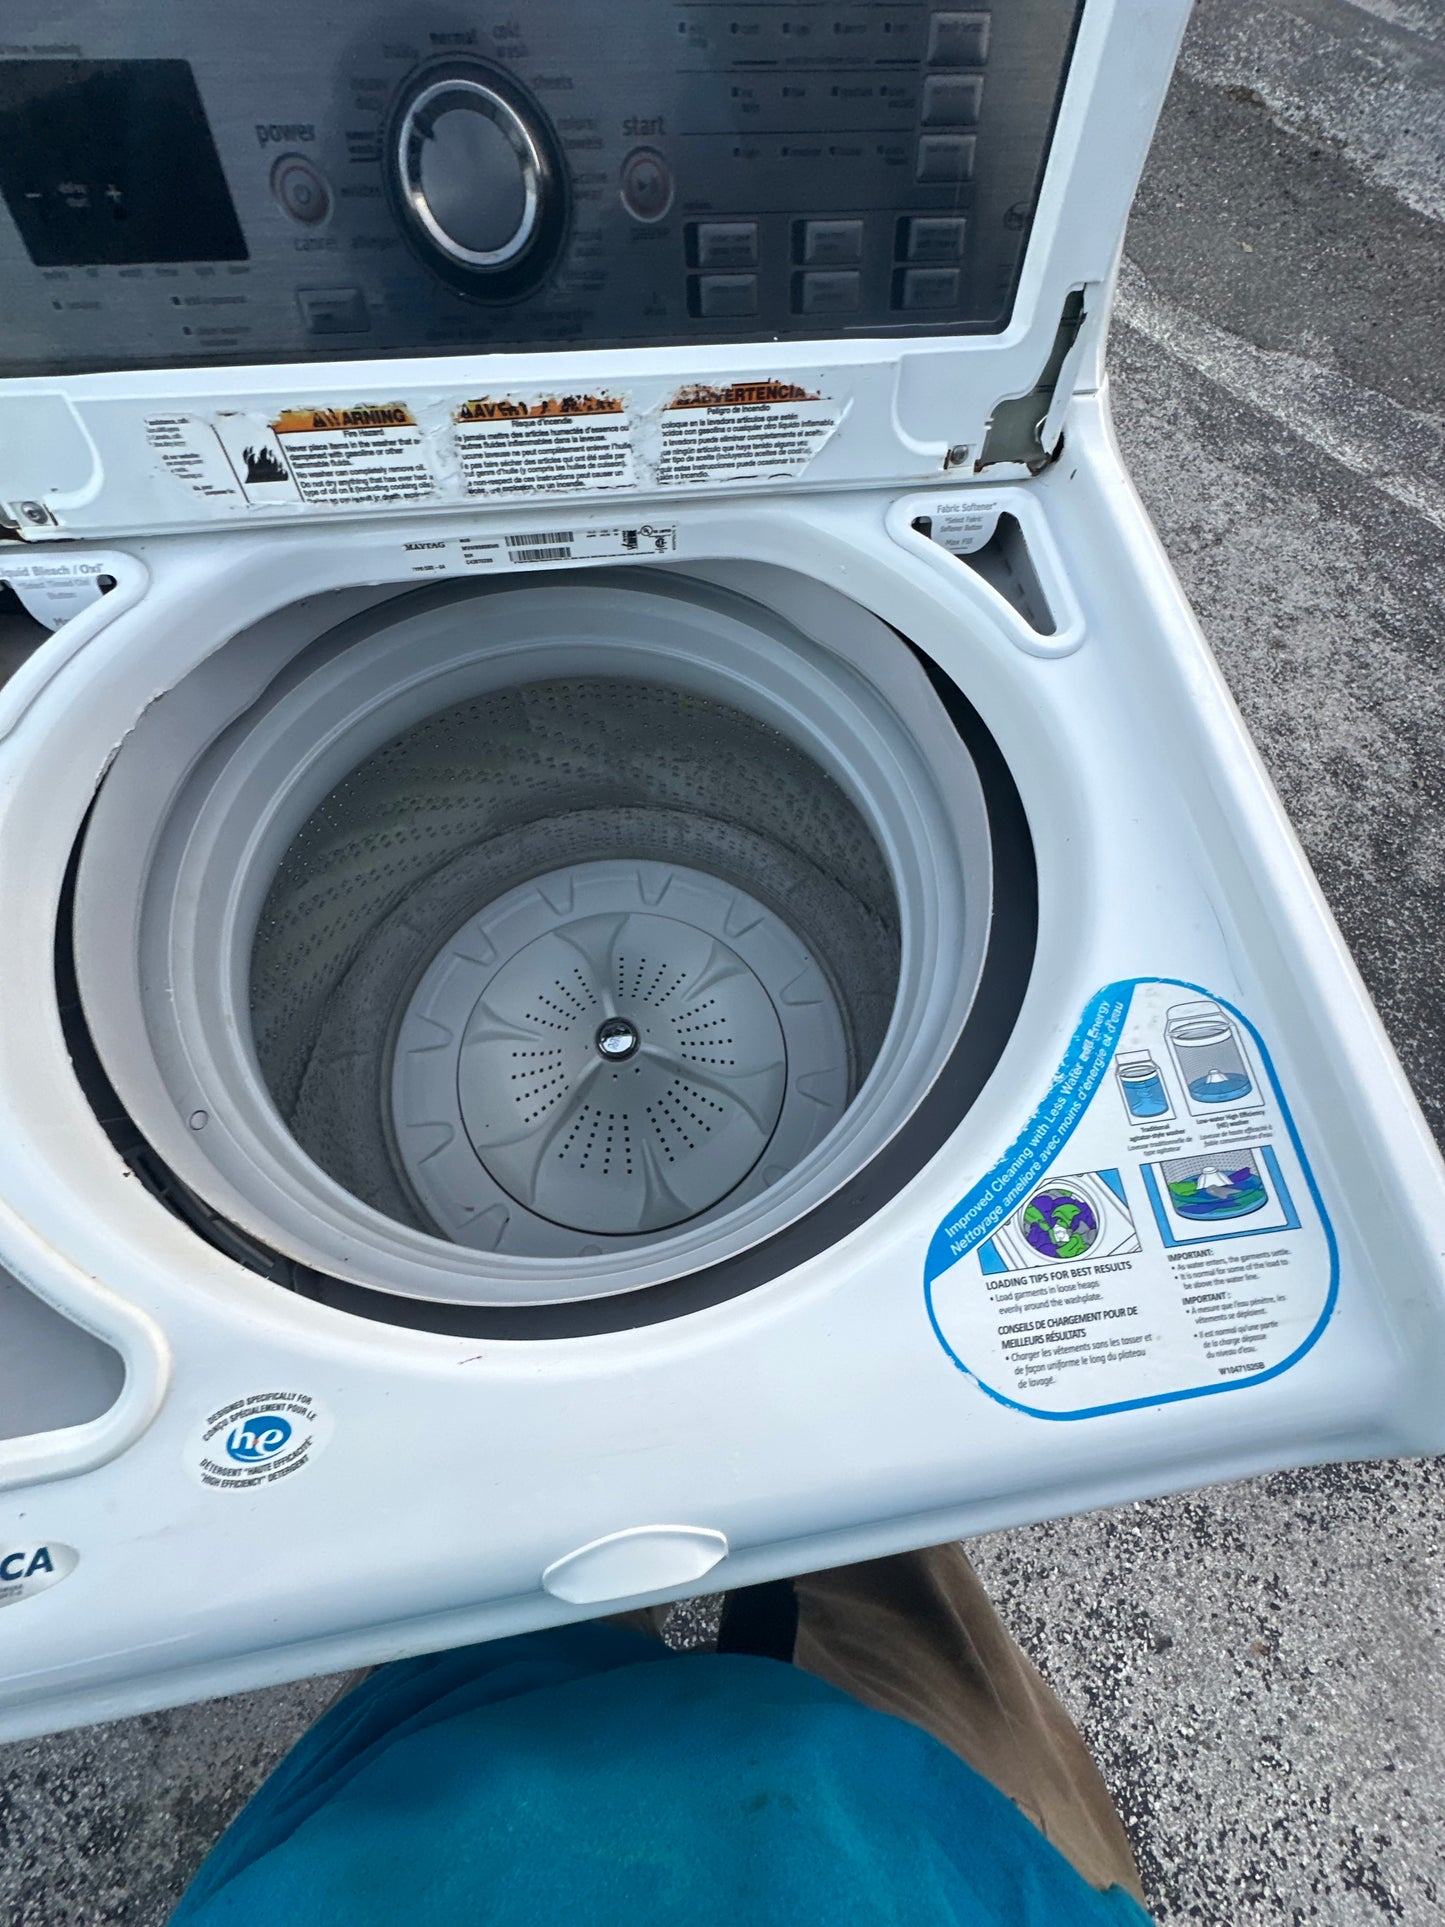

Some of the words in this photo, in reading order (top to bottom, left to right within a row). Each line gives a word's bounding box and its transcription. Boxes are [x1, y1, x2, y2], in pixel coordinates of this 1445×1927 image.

[255, 125, 315, 148] power
[622, 115, 666, 136] start
[936, 504, 960, 513] Fabric
[404, 541, 446, 551] MAYTAG
[1105, 1001, 1124, 1033] d'eau
[1102, 1035, 1114, 1047] et
[944, 1189, 995, 1238] Improved
[991, 1146, 1034, 1192] Cleaning
[1029, 1122, 1050, 1147] with
[1044, 1095, 1067, 1124] Less
[1060, 1062, 1085, 1096] Water
[1086, 999, 1112, 1038] Energy
[1057, 1100, 1082, 1136] moins
[1039, 1133, 1061, 1163] avec
[950, 1205, 1003, 1256] Nettoyage
[1167, 1248, 1214, 1262] IMPORTANT:
[986, 1275, 1028, 1291] LOADING
[1029, 1272, 1050, 1285] TIPS
[1050, 1269, 1069, 1281] FOR
[1071, 1266, 1092, 1278] BEST
[1094, 1260, 1132, 1274] RESULTS
[995, 1292, 1013, 1303] Load
[1014, 1286, 1049, 1300] garments
[1049, 1285, 1057, 1295] in
[1057, 1282, 1077, 1293] loose
[1078, 1279, 1101, 1292] heaps
[999, 1303, 1023, 1316] evenly
[1023, 1299, 1050, 1311] around
[1050, 1297, 1063, 1307] the
[998, 1321, 1035, 1336] CONSEILS
[1035, 1319, 1047, 1330] DE
[1046, 1310, 1102, 1329] CHARGEMENT
[1103, 1307, 1127, 1320] POUR
[1126, 1305, 1138, 1317] DE
[1001, 1334, 1045, 1350] MEILLEURS
[1045, 1328, 1087, 1342] RÉSULTATS
[1011, 1350, 1040, 1363] Charger
[1041, 1348, 1052, 1357] les
[1109, 1337, 1121, 1346] les
[1121, 1334, 1143, 1345] tasser
[1144, 1333, 1153, 1342] et
[1014, 1365, 1025, 1376] de
[1046, 1357, 1081, 1371] uniforme
[1081, 1356, 1089, 1365] le
[1089, 1353, 1107, 1364] long
[1107, 1352, 1117, 1362] du
[1118, 1349, 1147, 1362] plateau
[1017, 1379, 1027, 1389] de
[206, 1398, 245, 1425] DESIGNED
[246, 1391, 297, 1406] SPECIFICALLY
[297, 1393, 313, 1406] FOR
[286, 1403, 307, 1416] POUR
[306, 1410, 318, 1422] LE
[230, 1423, 284, 1456] he
[267, 1453, 310, 1483] DETERGENT
